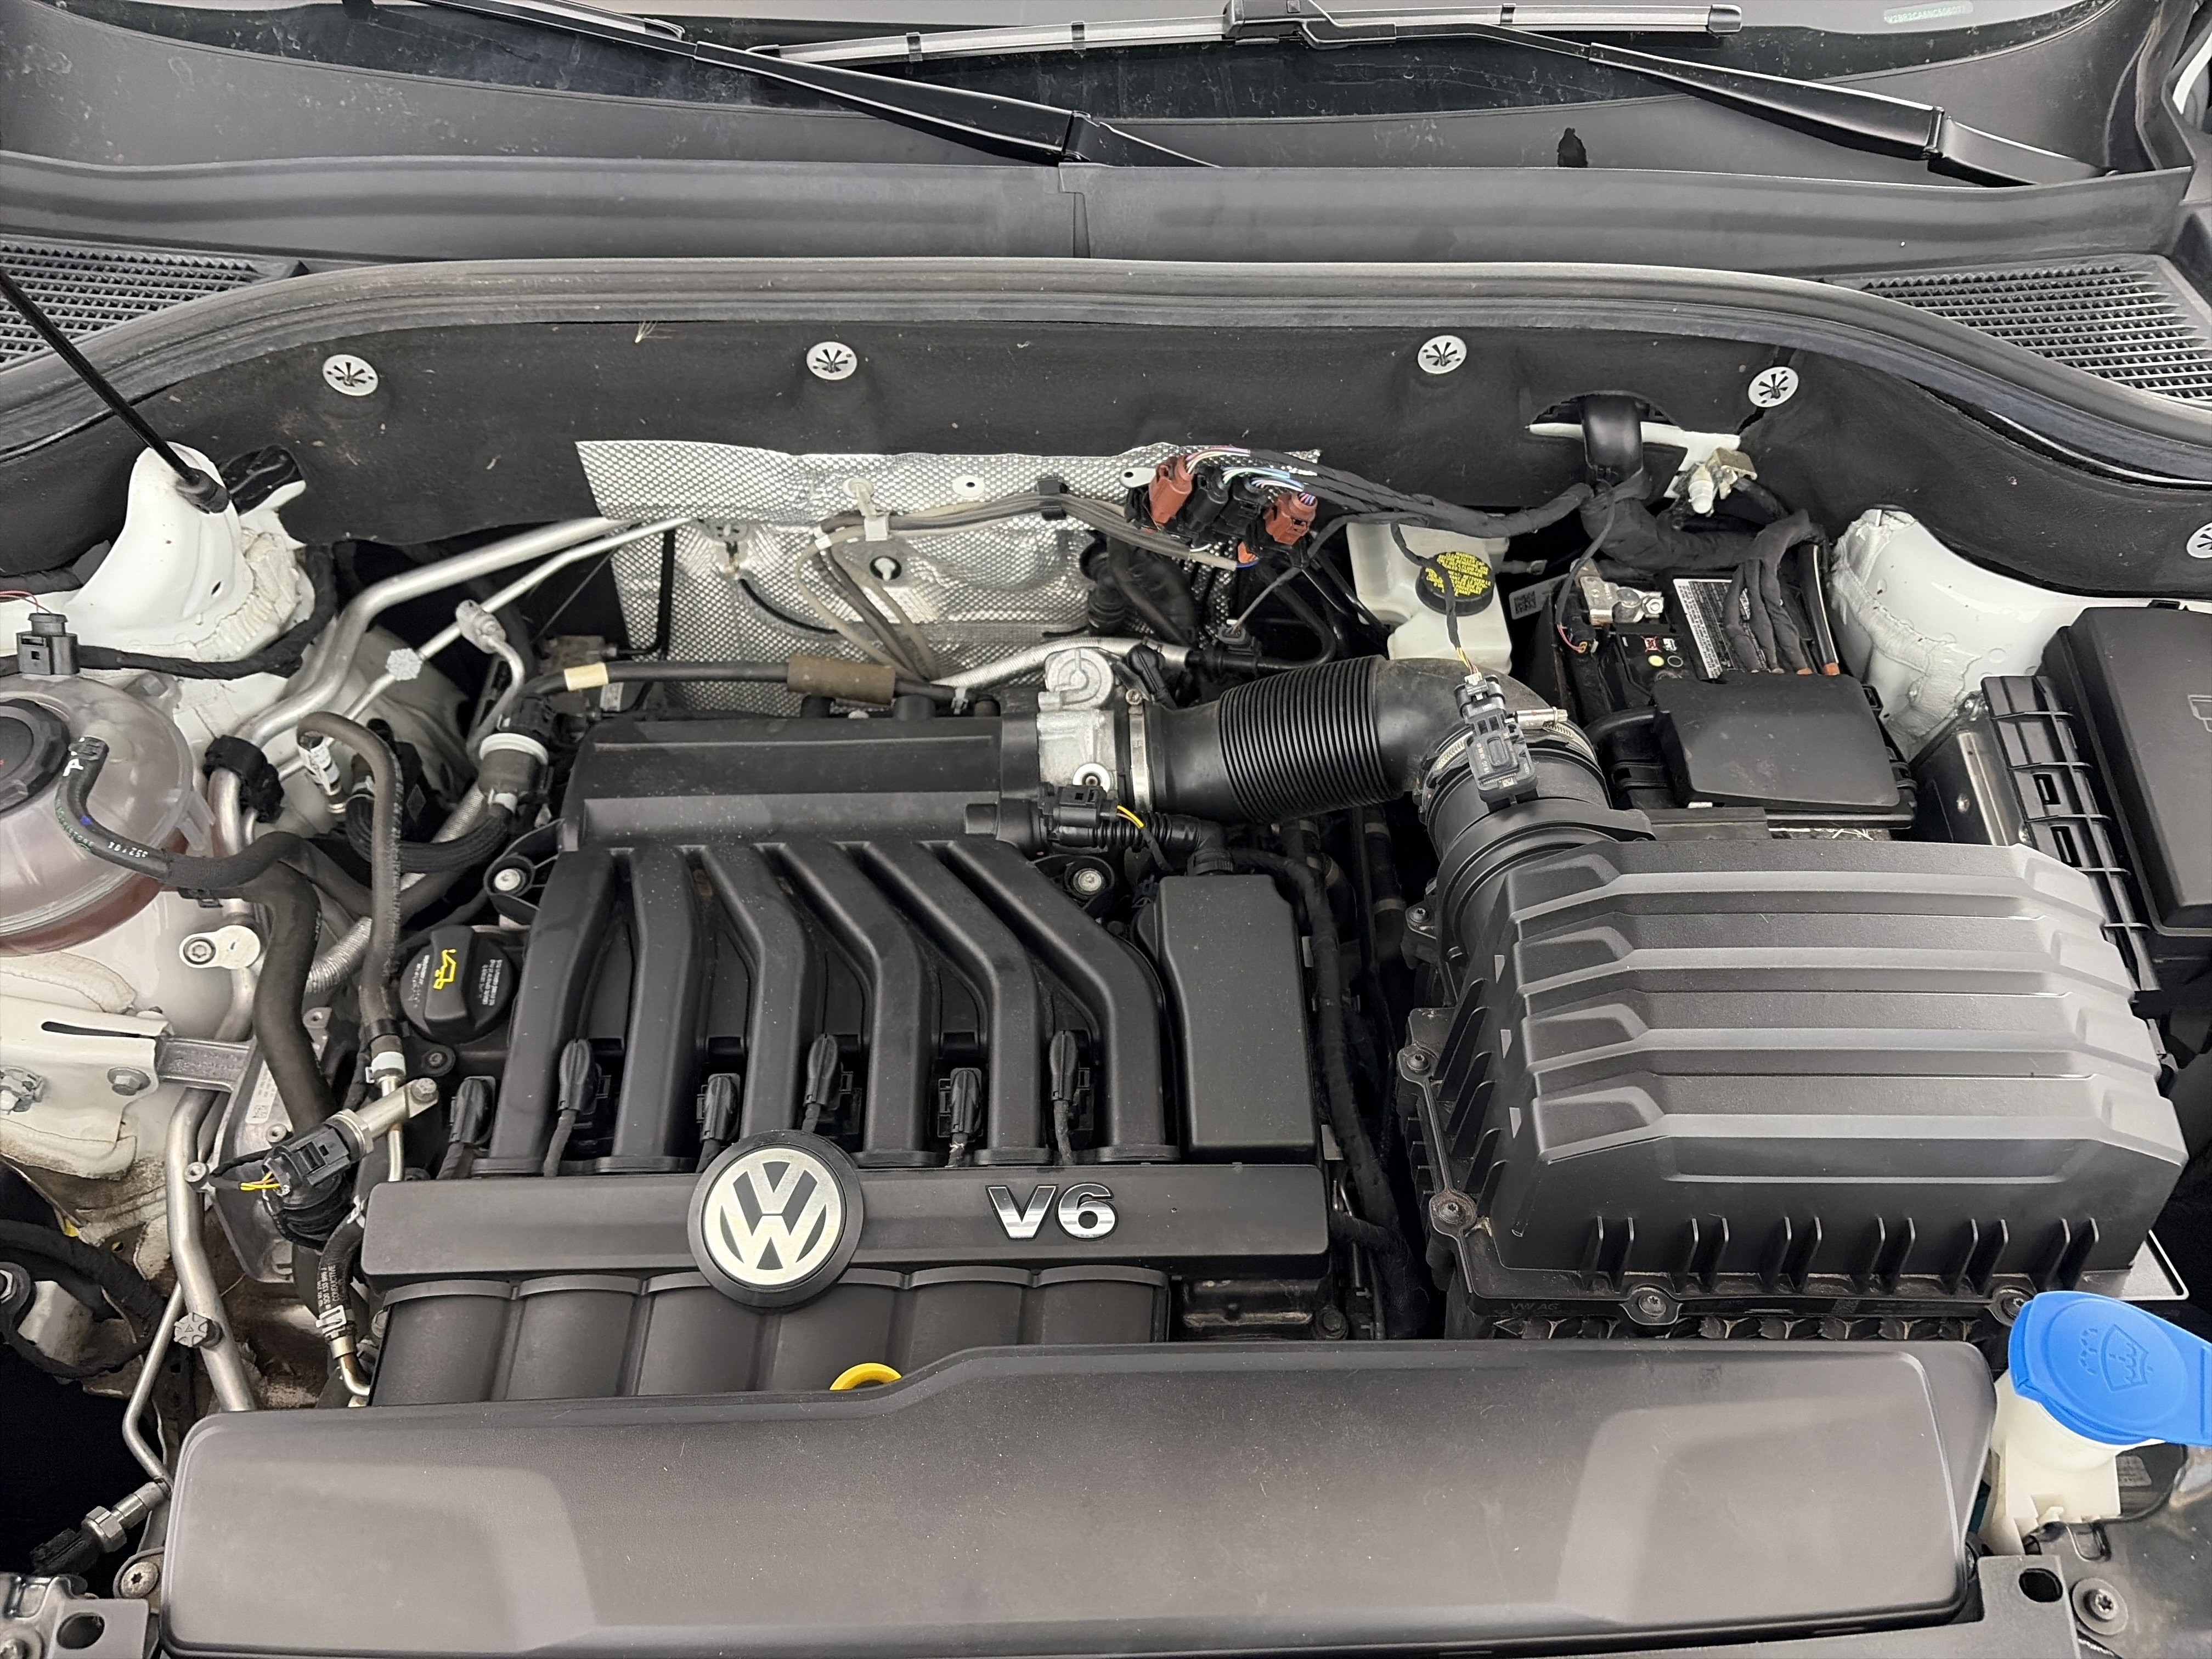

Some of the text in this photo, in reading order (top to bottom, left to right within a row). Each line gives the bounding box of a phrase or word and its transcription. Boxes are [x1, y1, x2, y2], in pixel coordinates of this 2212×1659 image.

[706, 1148, 841, 1285] VW
[985, 1182, 1118, 1241] V6
[328, 1265, 340, 1301] CONDUCTIVE
